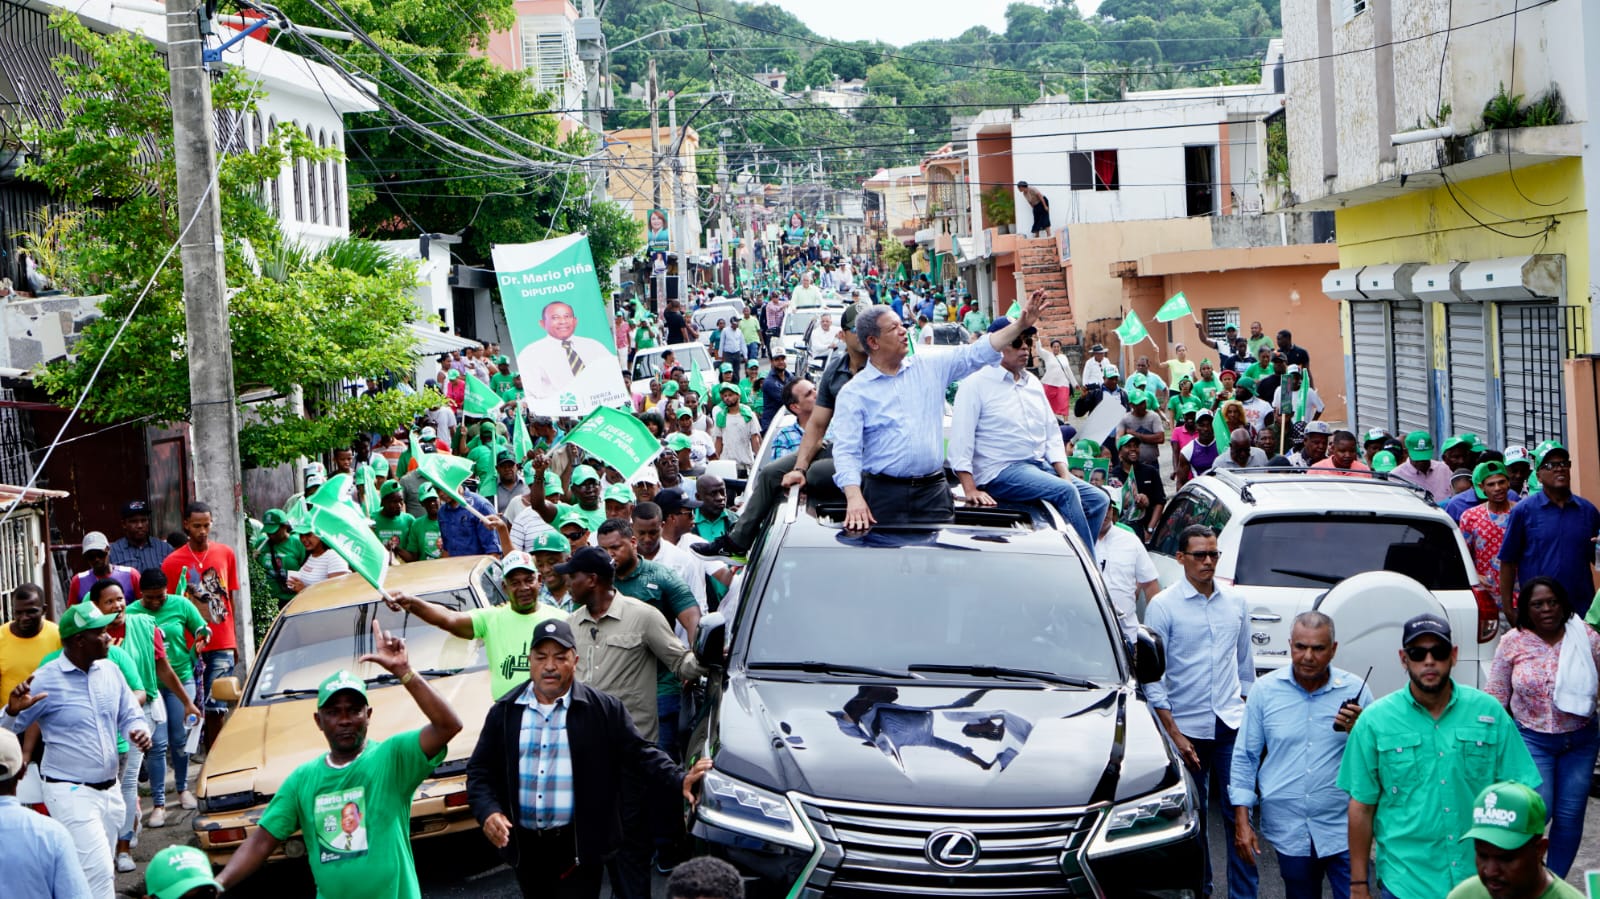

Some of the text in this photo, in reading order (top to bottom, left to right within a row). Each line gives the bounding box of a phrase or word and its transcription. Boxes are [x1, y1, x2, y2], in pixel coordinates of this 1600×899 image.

[500, 263, 593, 286] Dr. Mario Piña
[521, 281, 575, 298] DIPUTADO
[604, 424, 634, 444] FUERZA
[598, 430, 640, 463] DEL PUEBLO
